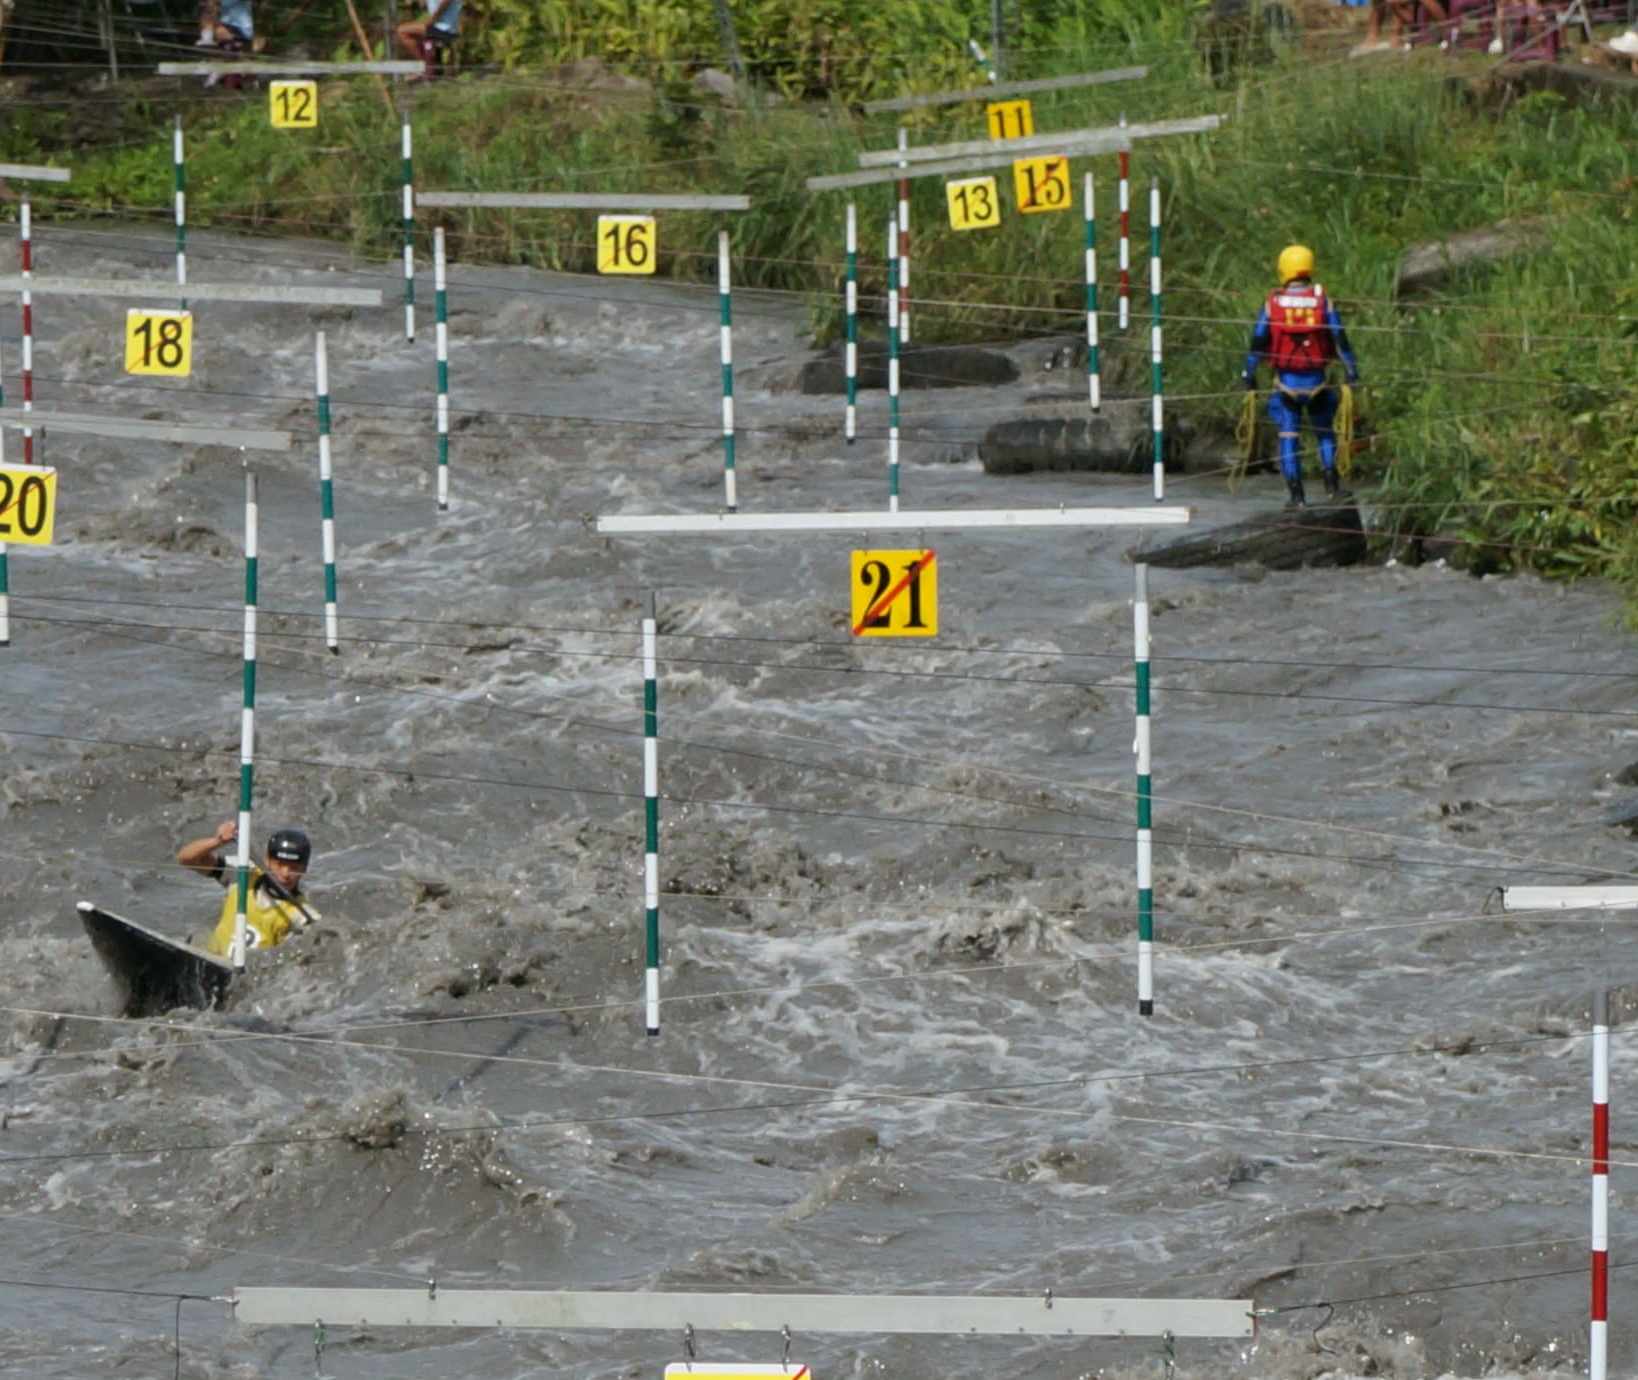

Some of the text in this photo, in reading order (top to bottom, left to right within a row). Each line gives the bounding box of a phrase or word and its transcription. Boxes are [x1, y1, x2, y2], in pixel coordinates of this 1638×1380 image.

[275, 87, 312, 122] 12
[992, 106, 1026, 138] 11
[954, 185, 992, 222] 13
[1020, 163, 1065, 206] 15
[605, 224, 648, 266] 16
[134, 318, 183, 368] 18
[861, 560, 929, 629] 21
